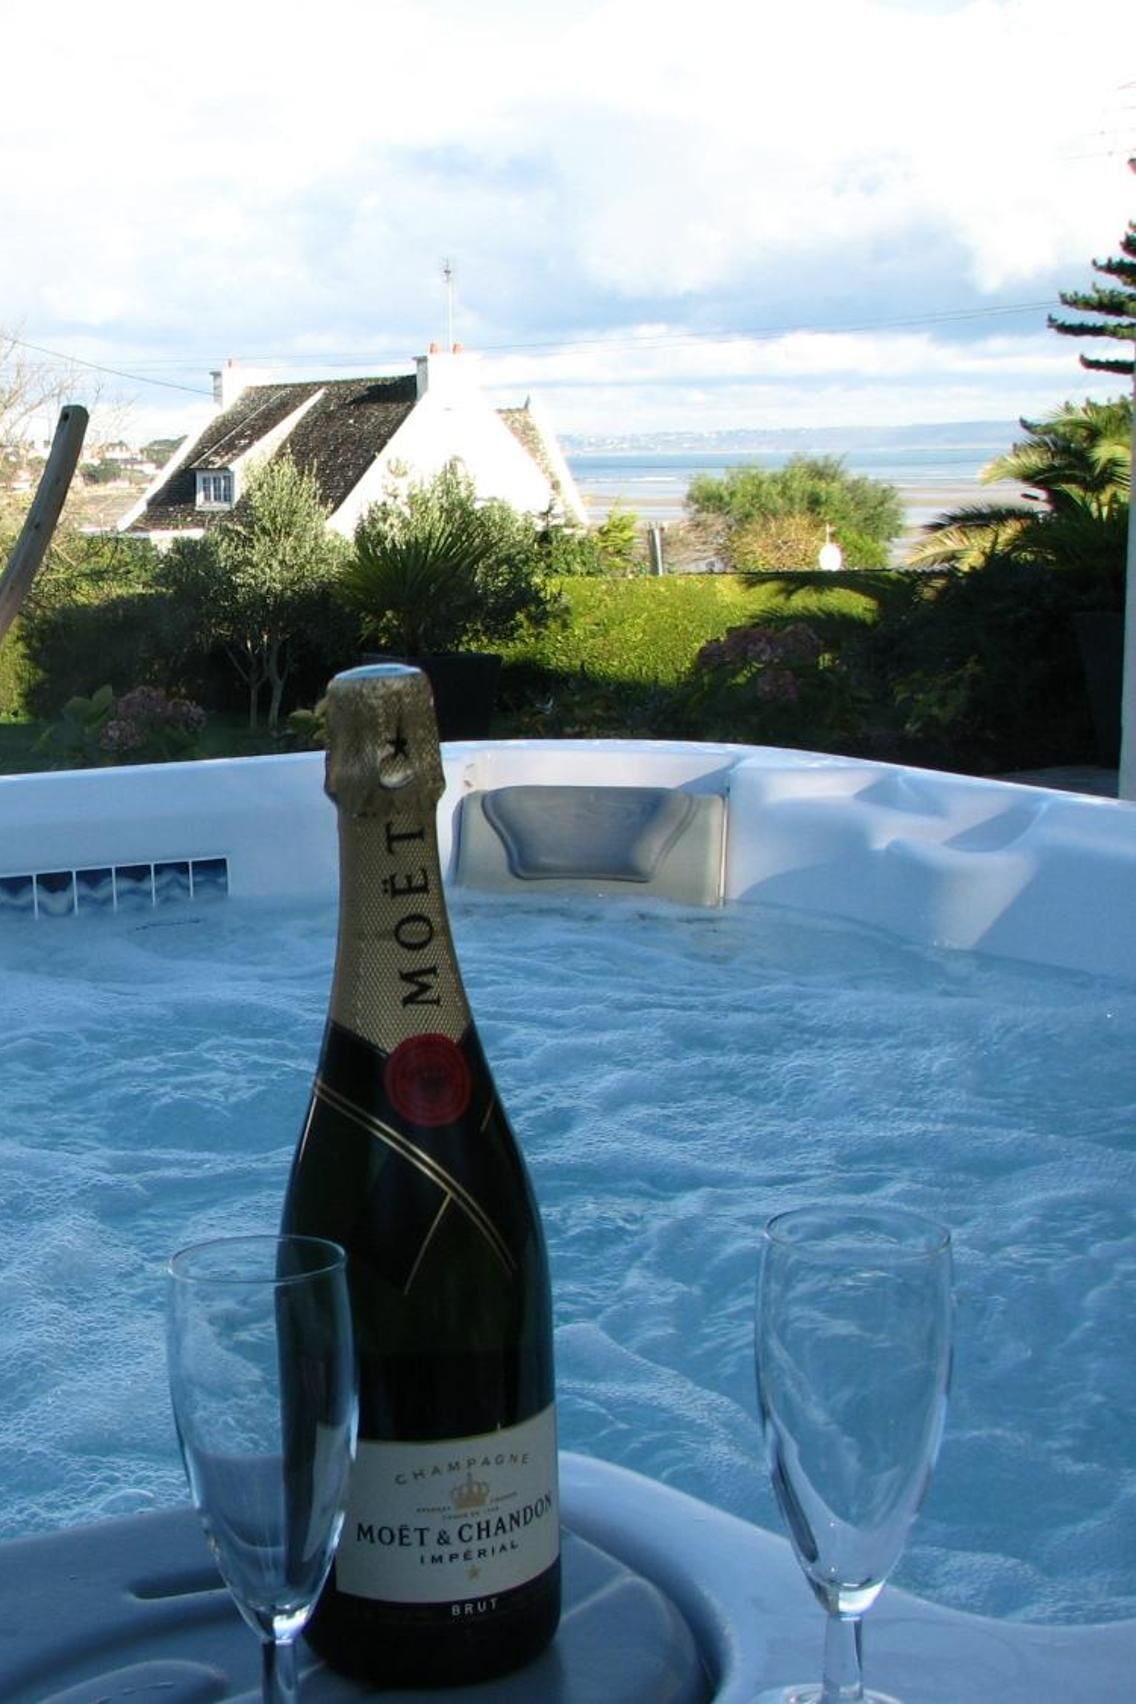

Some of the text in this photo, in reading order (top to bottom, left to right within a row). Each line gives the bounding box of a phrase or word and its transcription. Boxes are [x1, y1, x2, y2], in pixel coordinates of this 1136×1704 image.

[383, 820, 440, 1009] MOËT
[394, 1452, 530, 1486] CHAMPAGNE
[356, 1522, 430, 1547] MOËT
[436, 1530, 451, 1546] &
[457, 1489, 552, 1544] CHANDON
[451, 1598, 499, 1616] BRUT
